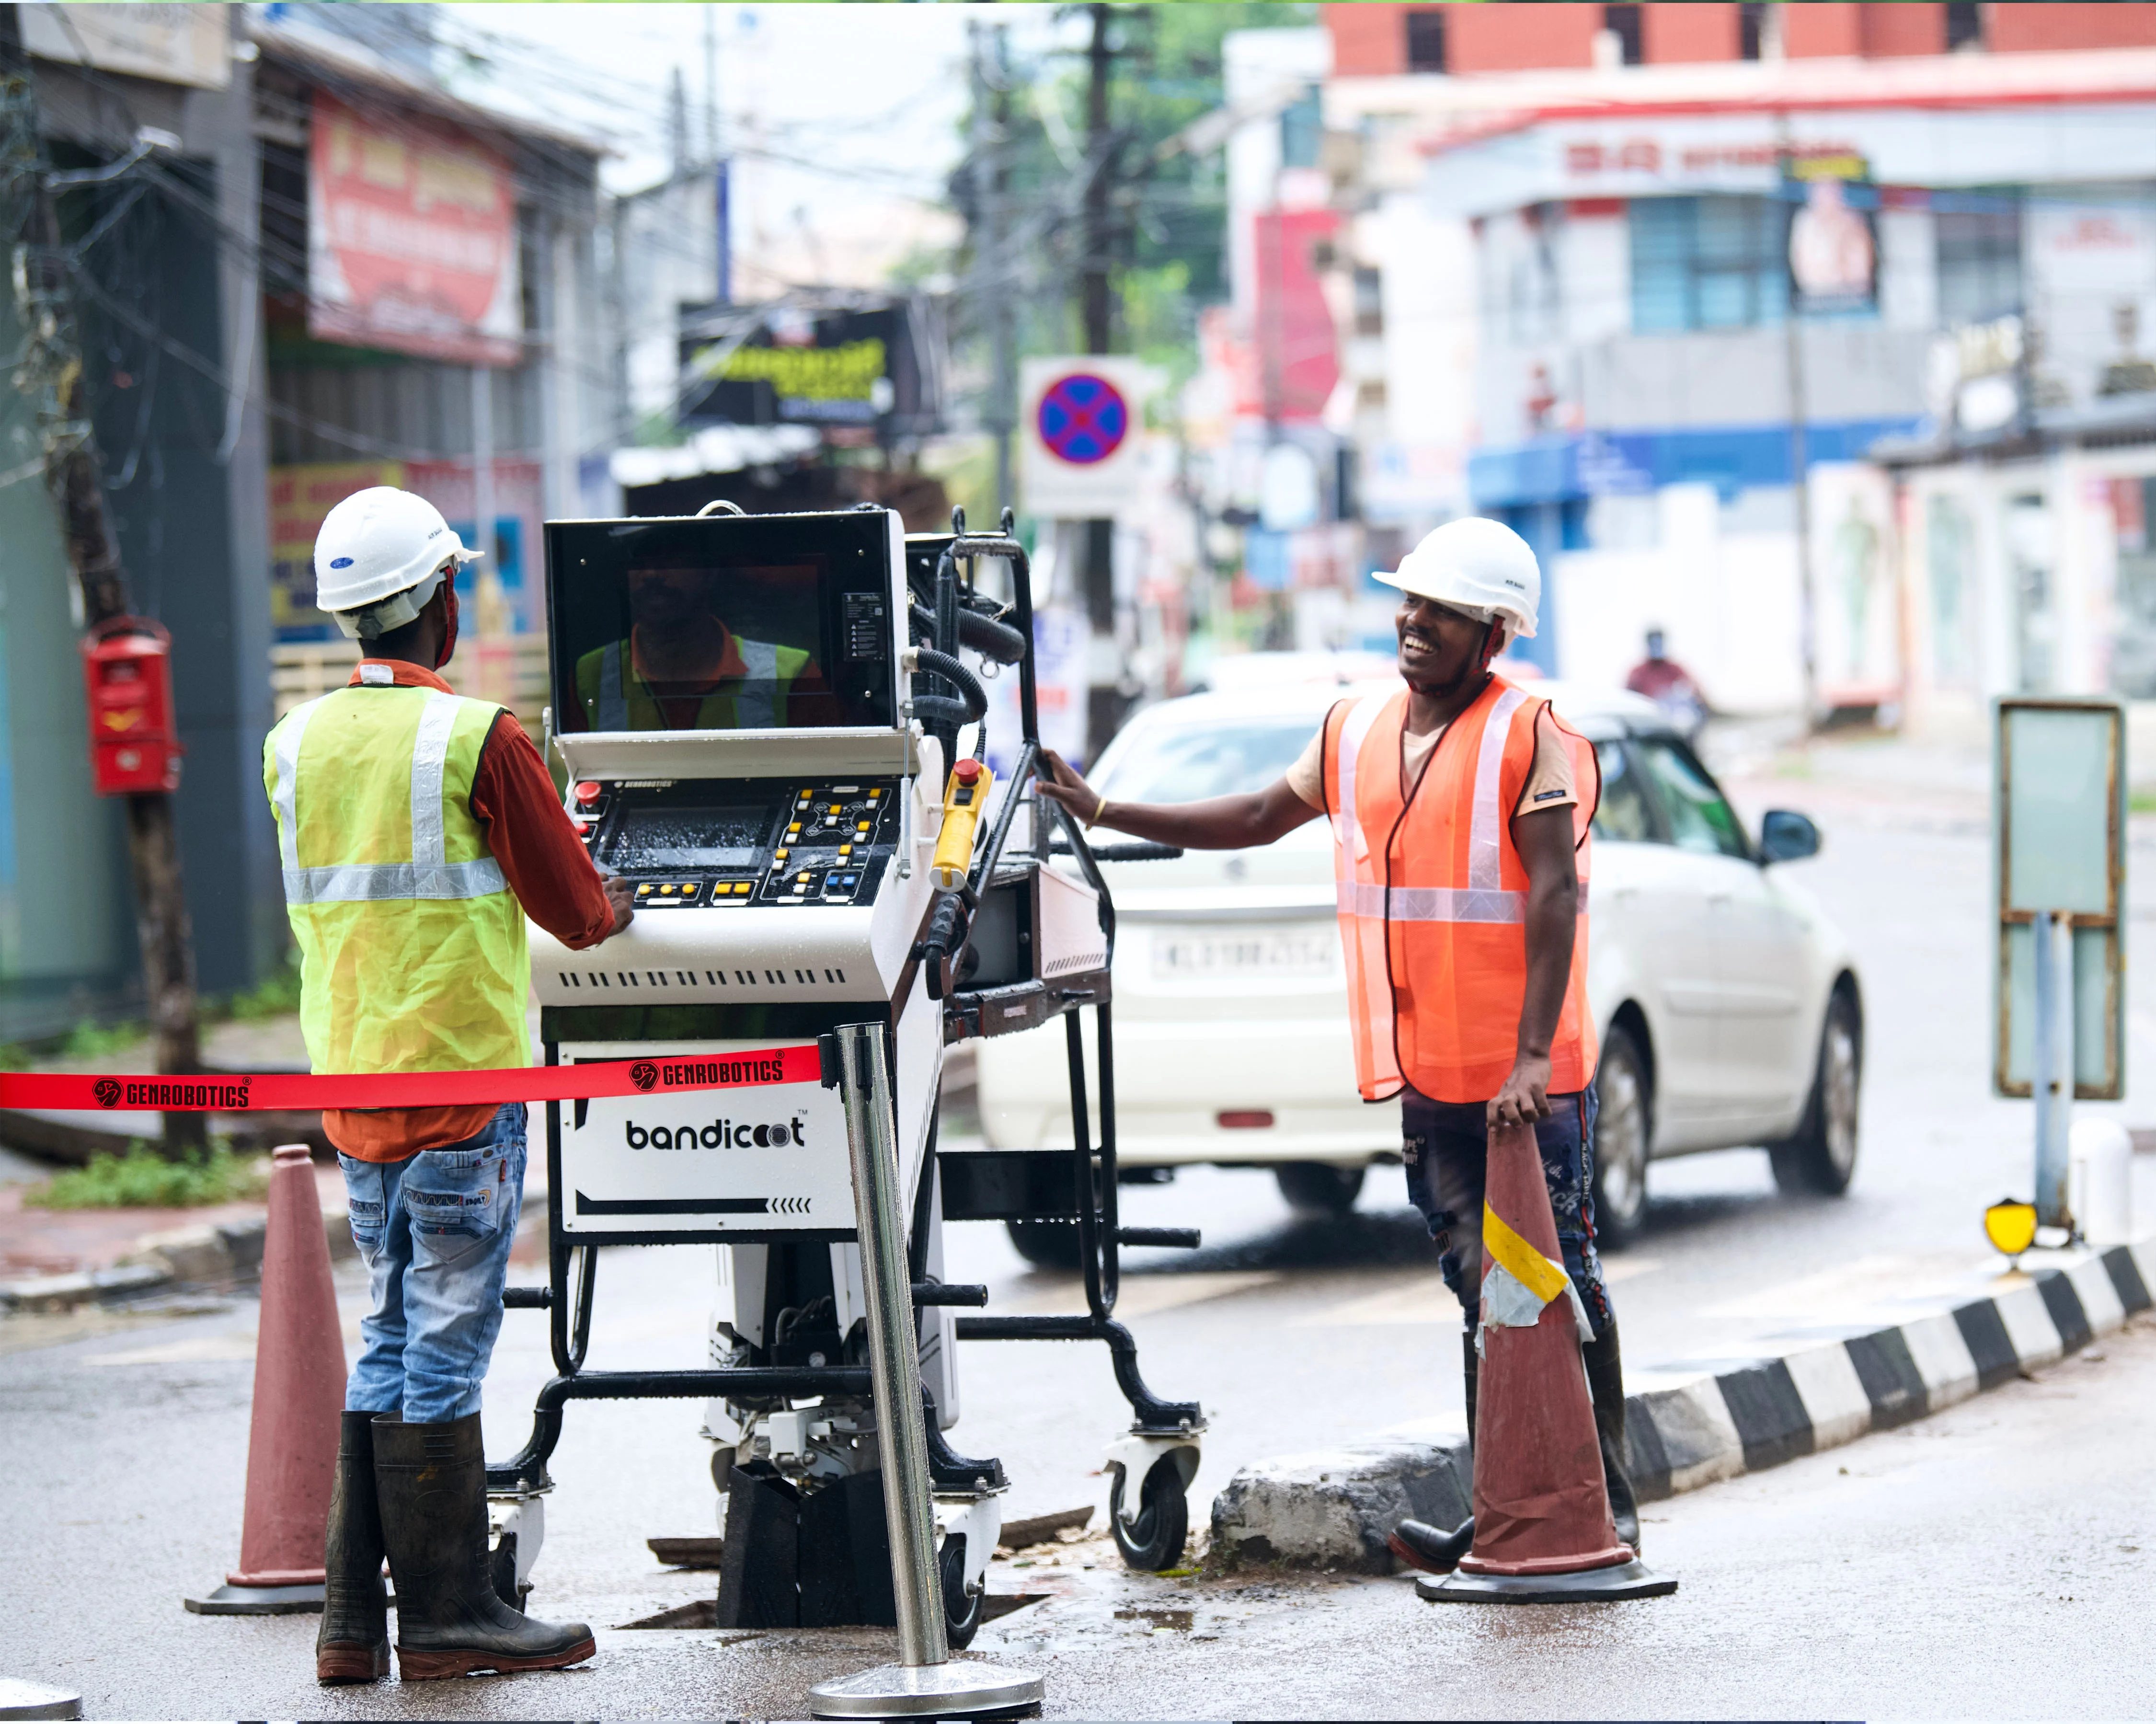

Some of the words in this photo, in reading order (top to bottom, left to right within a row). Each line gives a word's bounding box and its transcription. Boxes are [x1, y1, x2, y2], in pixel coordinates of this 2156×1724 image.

[663, 1060, 783, 1086] GENROBOTICS
[127, 1084, 249, 1107] GENROBOTICS
[626, 1117, 804, 1150] bandicoot
